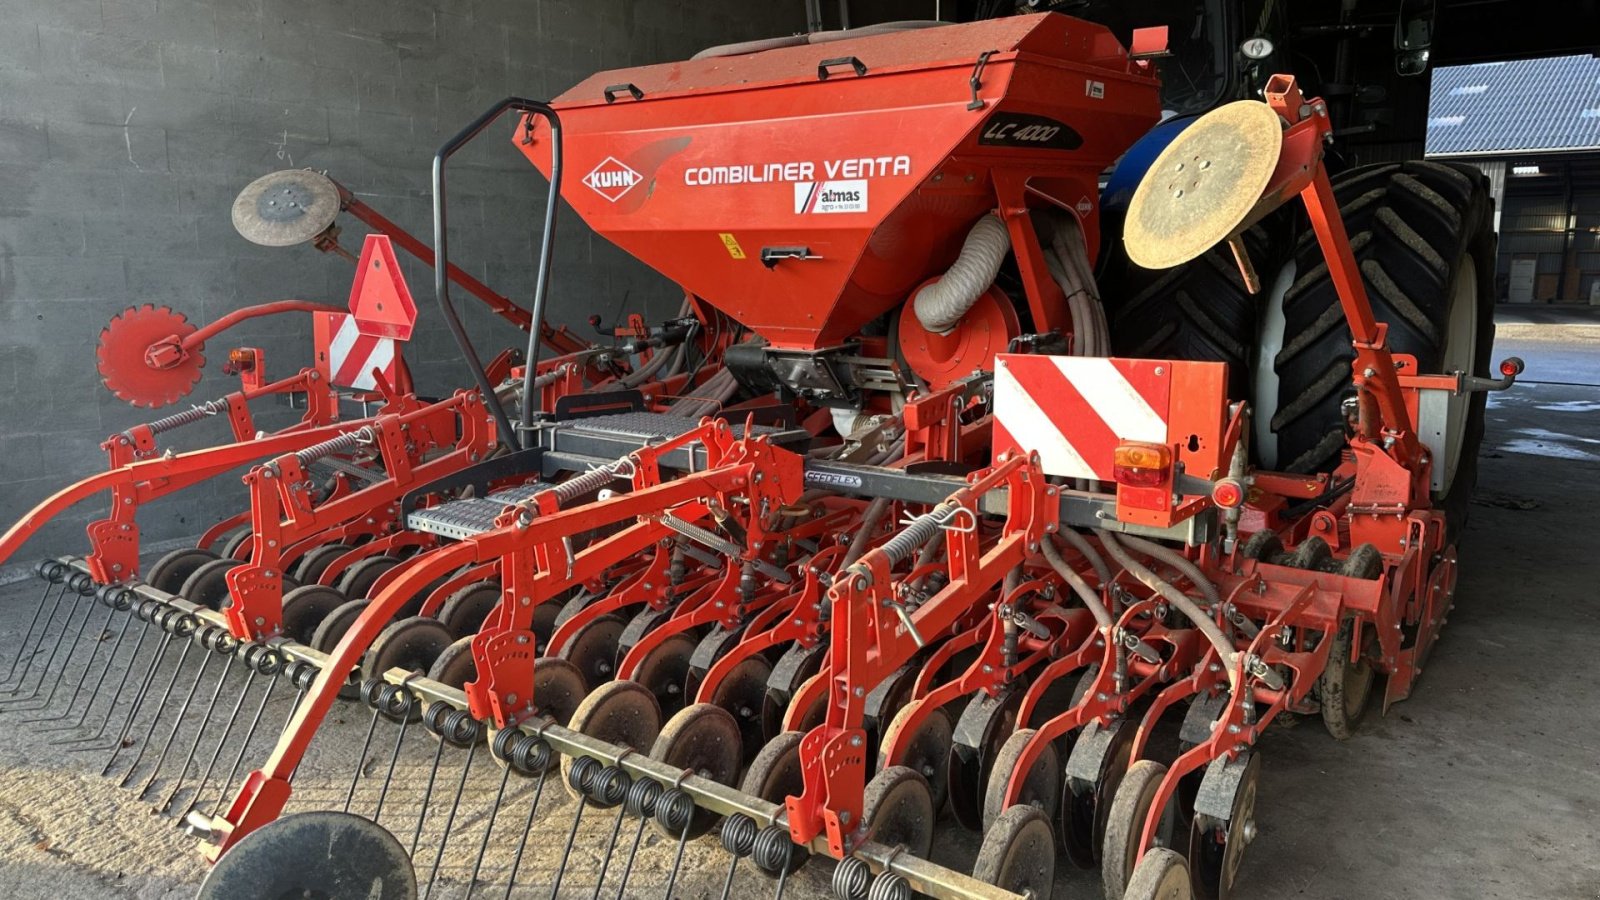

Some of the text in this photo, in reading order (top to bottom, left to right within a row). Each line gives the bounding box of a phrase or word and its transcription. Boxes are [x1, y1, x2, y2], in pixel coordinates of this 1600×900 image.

[984, 122, 1060, 141] LC 4000
[590, 170, 635, 188] KUHN
[684, 155, 911, 185] COMBILINER VENTA
[821, 189, 860, 202] almas
